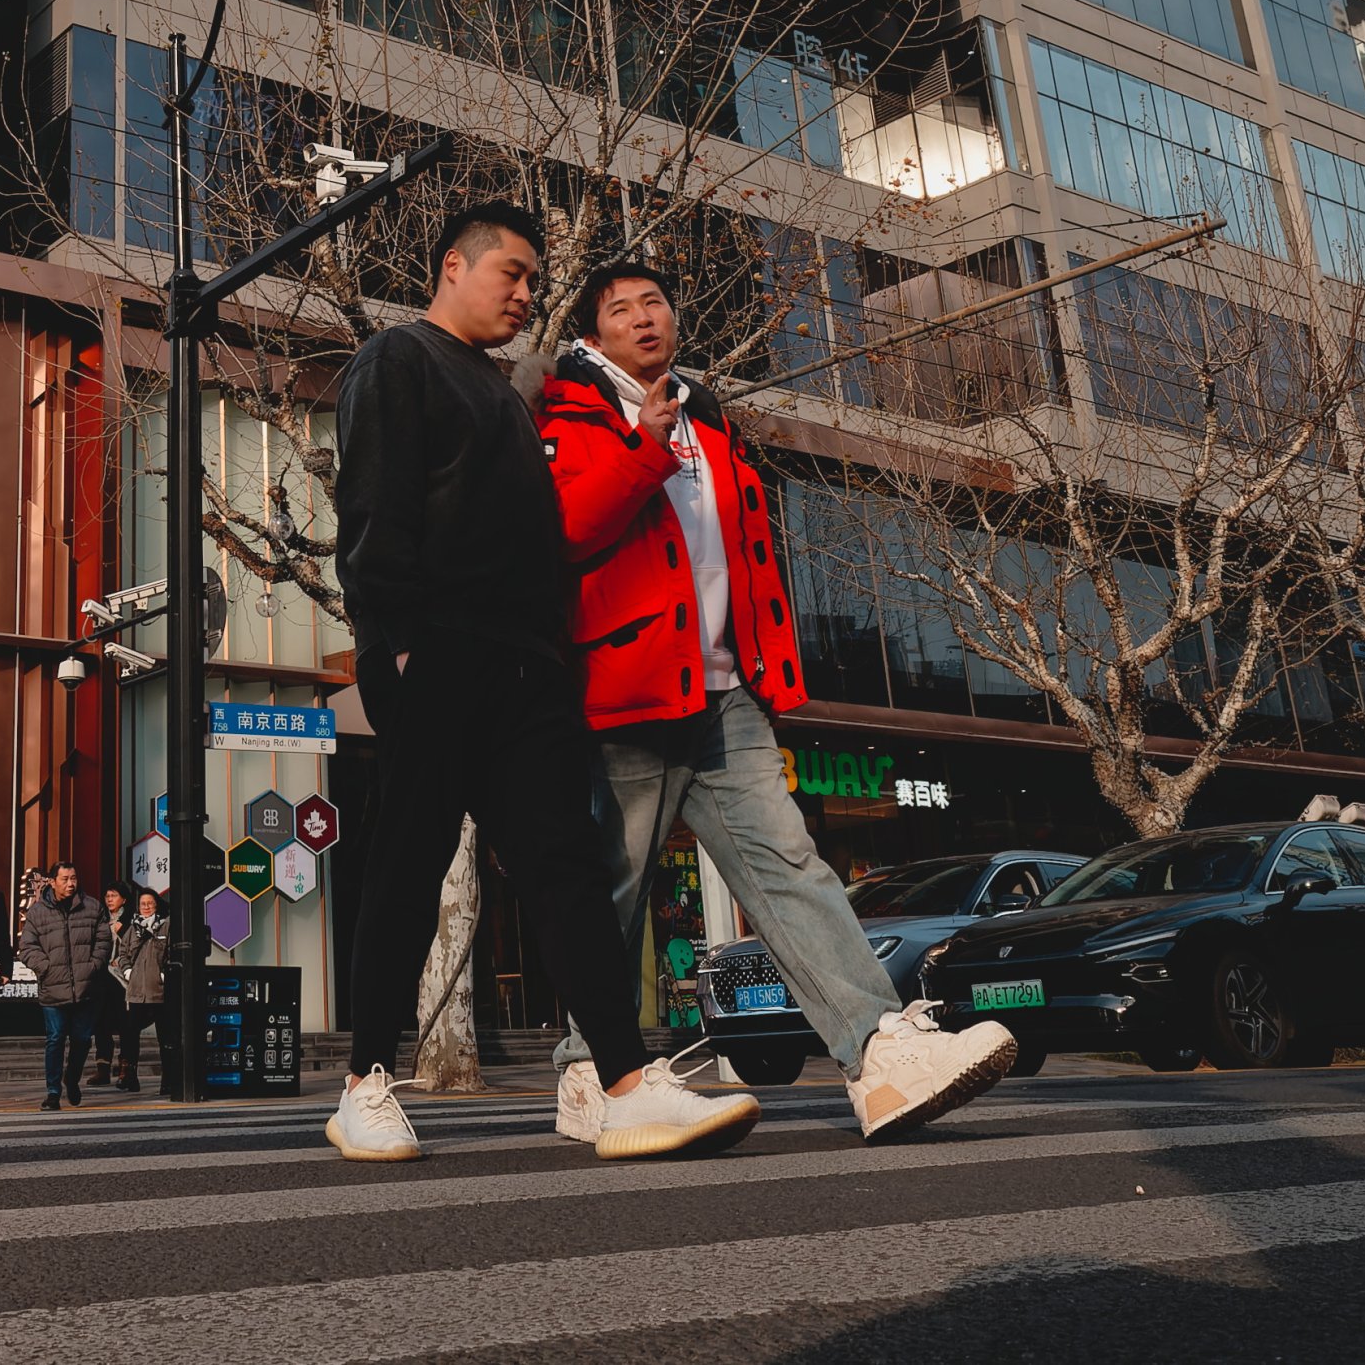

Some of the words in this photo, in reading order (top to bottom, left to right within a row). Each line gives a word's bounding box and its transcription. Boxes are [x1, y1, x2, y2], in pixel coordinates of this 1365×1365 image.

[215, 708, 225, 720] 西
[237, 710, 306, 732] 南京西路
[319, 714, 328, 725] 东
[213, 722, 229, 732] 758
[315, 727, 331, 737] 580
[215, 736, 225, 746] W
[241, 737, 271, 748] Nanjing
[320, 740, 328, 751] E
[894, 778, 950, 810] 赛百味
[231, 864, 267, 874] SUBWAY
